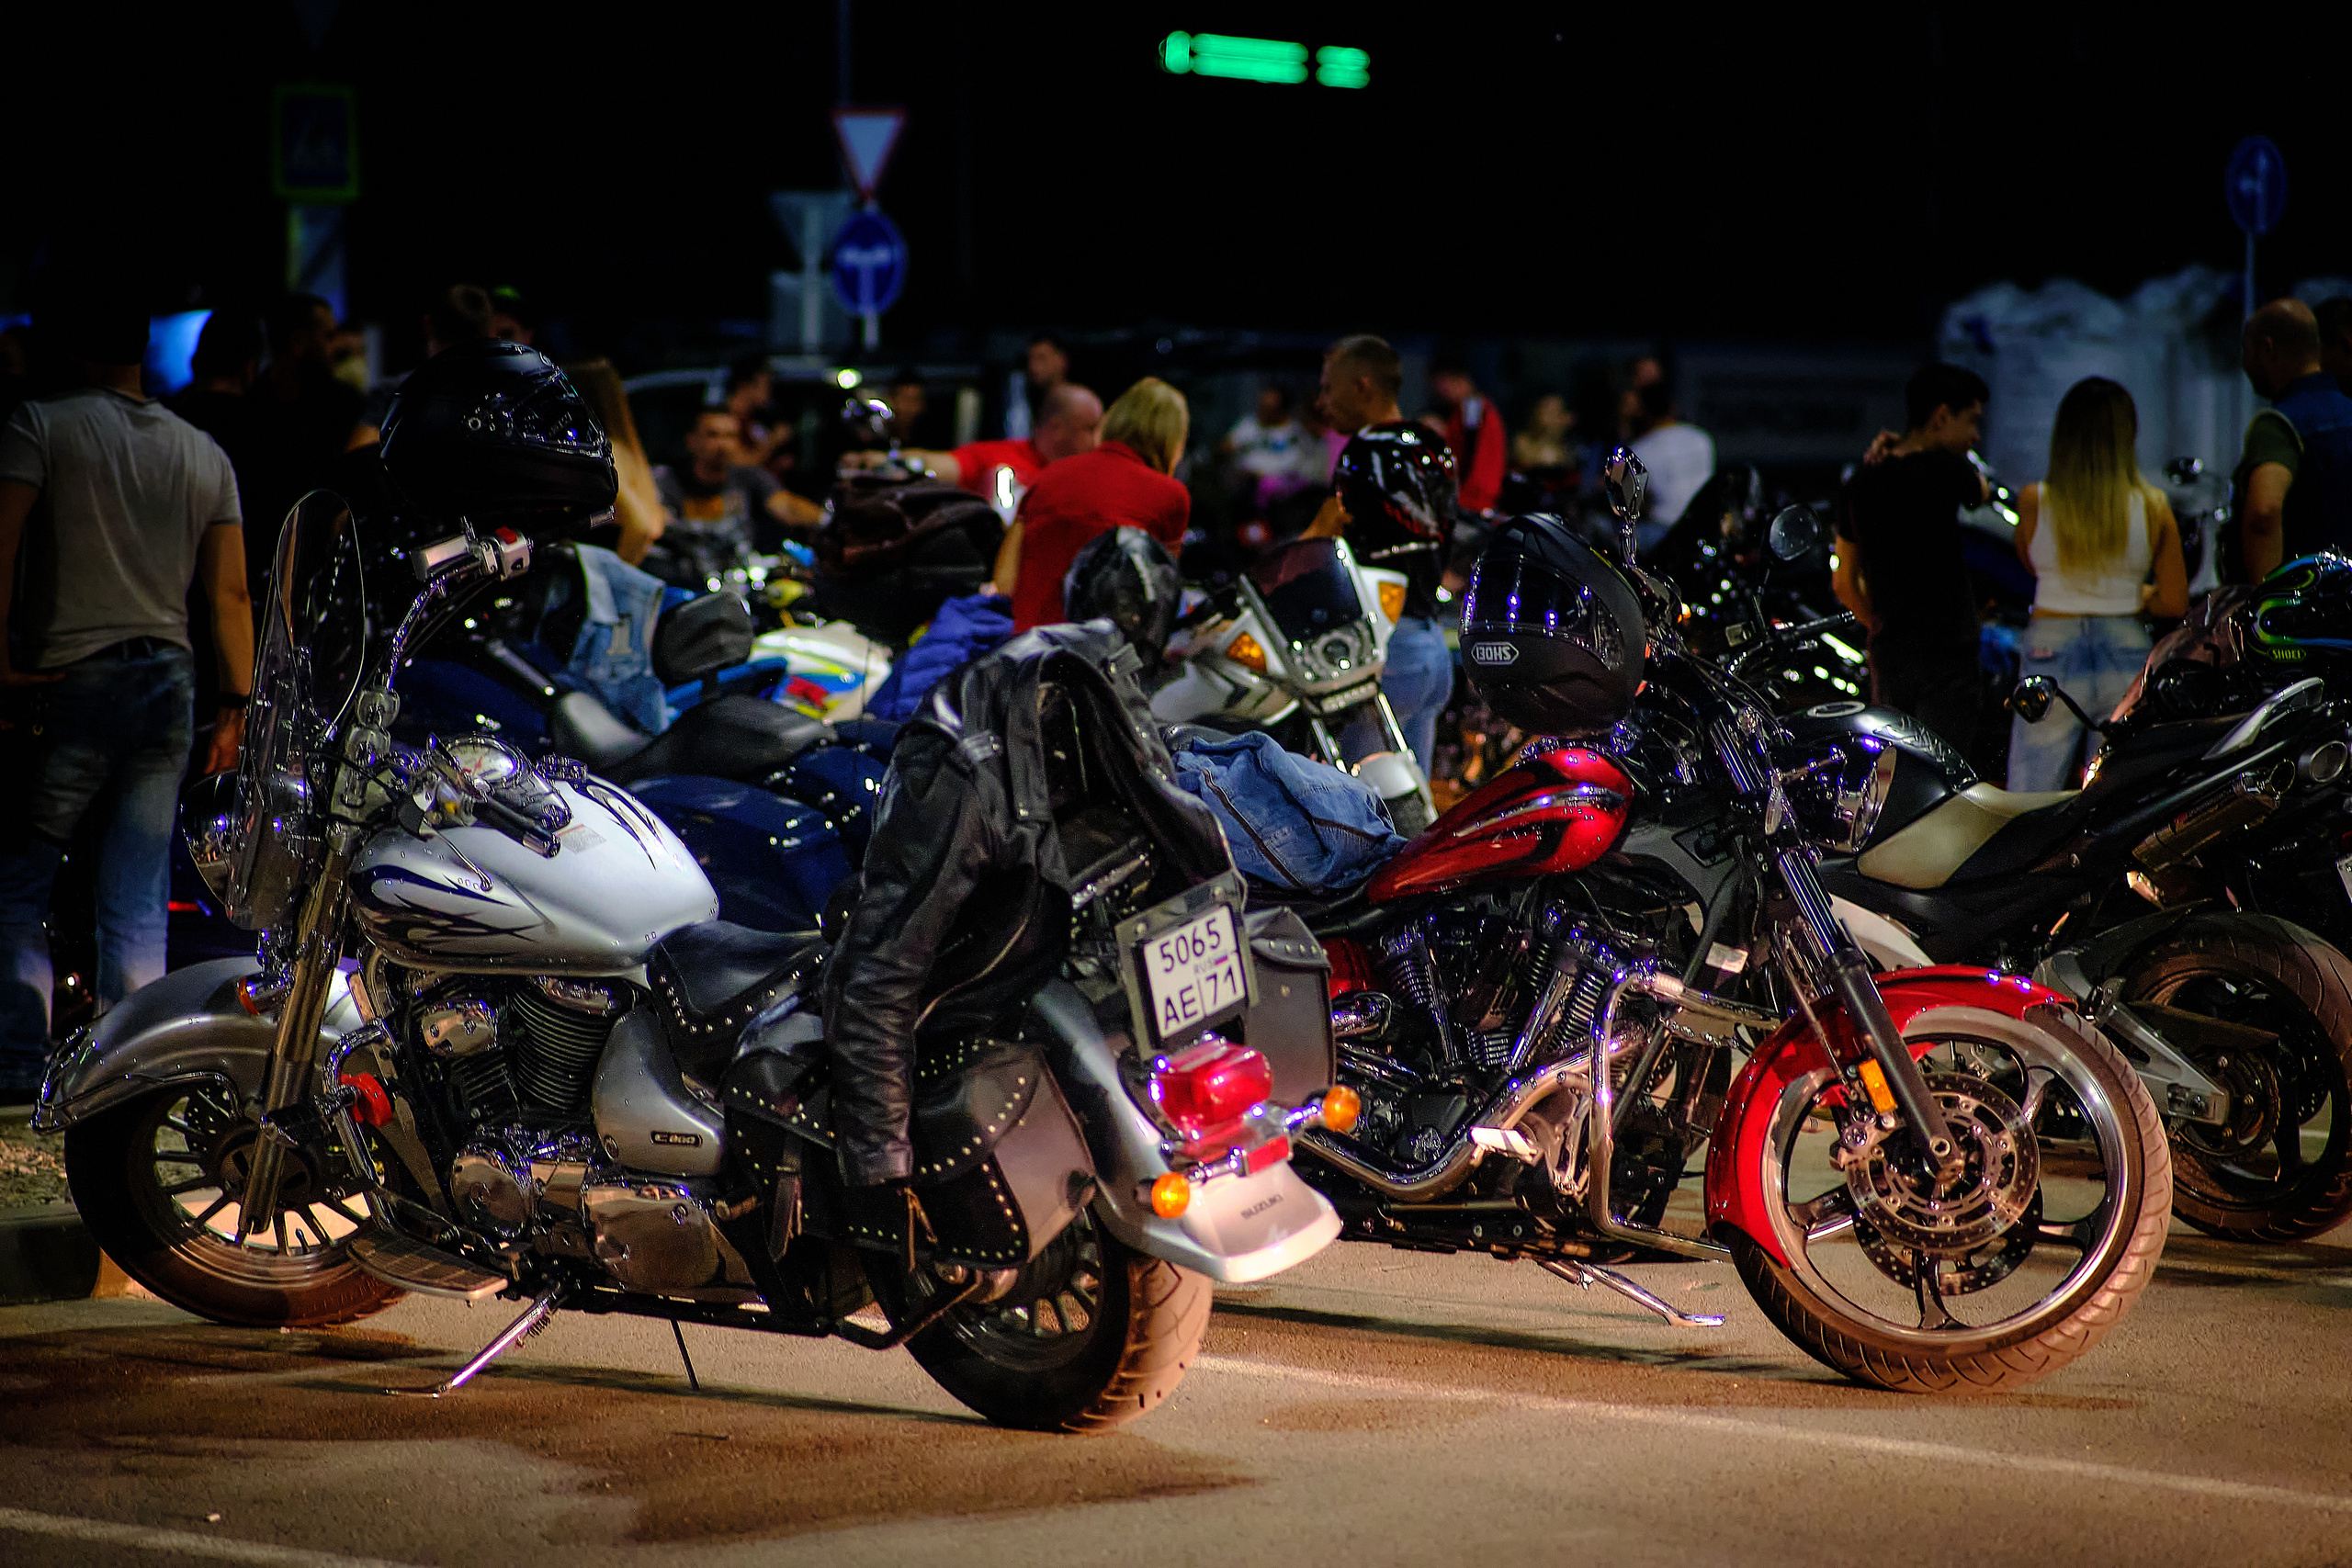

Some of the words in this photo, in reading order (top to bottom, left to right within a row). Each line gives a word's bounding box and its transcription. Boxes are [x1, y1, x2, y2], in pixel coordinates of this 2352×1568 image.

[1476, 646, 1512, 661] SHOEI
[2272, 649, 2301, 660] SHOEI
[1159, 918, 1221, 973] 5065
[1164, 984, 1198, 1030] AE
[1205, 965, 1237, 1006] 71
